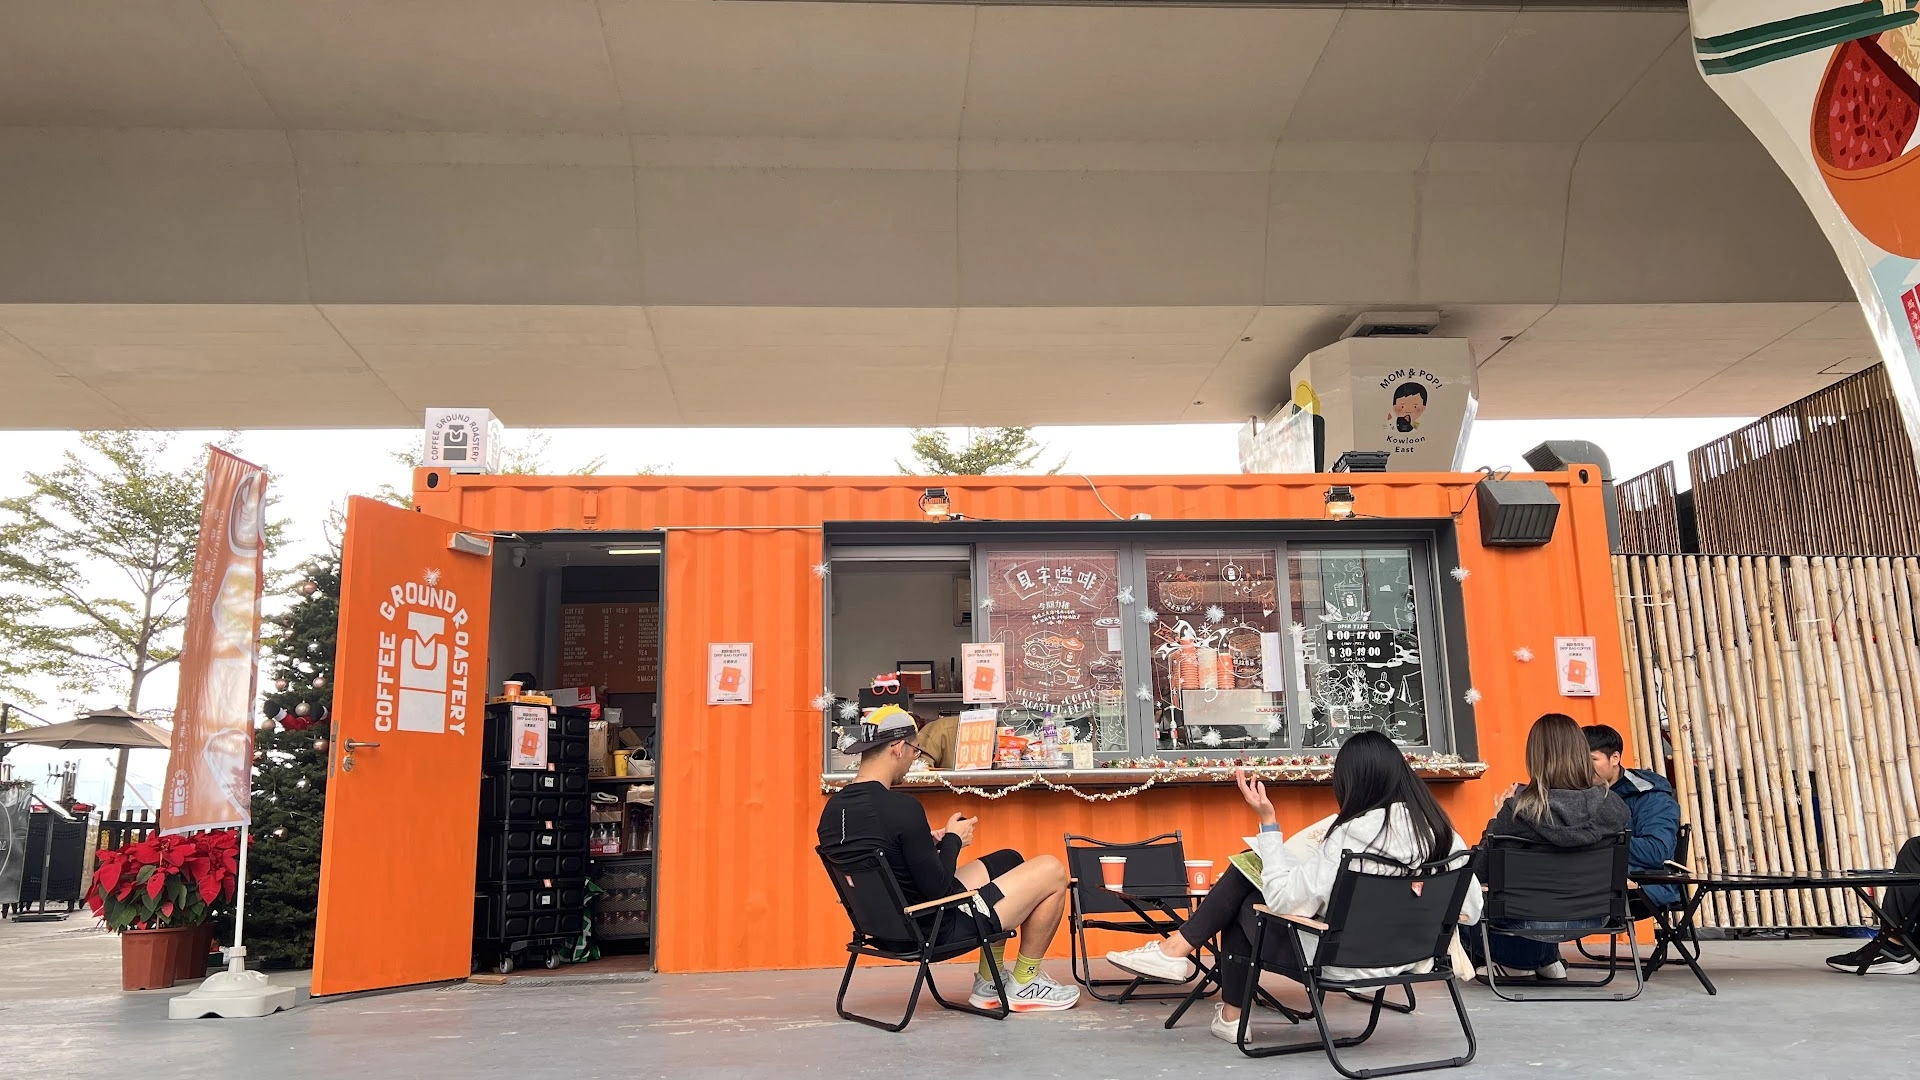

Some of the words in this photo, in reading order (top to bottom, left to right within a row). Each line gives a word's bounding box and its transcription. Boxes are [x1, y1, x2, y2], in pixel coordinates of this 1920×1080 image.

[1379, 368, 1406, 390] MOM
[1408, 367, 1416, 379] &
[1419, 369, 1443, 389] POP!
[431, 430, 440, 461] COFFEE
[436, 413, 470, 430] GROUND
[469, 421, 480, 463] ROASTERY
[1386, 434, 1426, 445] Kowloon
[1395, 445, 1414, 454] East
[379, 581, 457, 622] GROUND
[375, 632, 397, 732] COFFEE
[449, 607, 469, 736] ROASTERY
[1016, 688, 1050, 702] HOUSE
